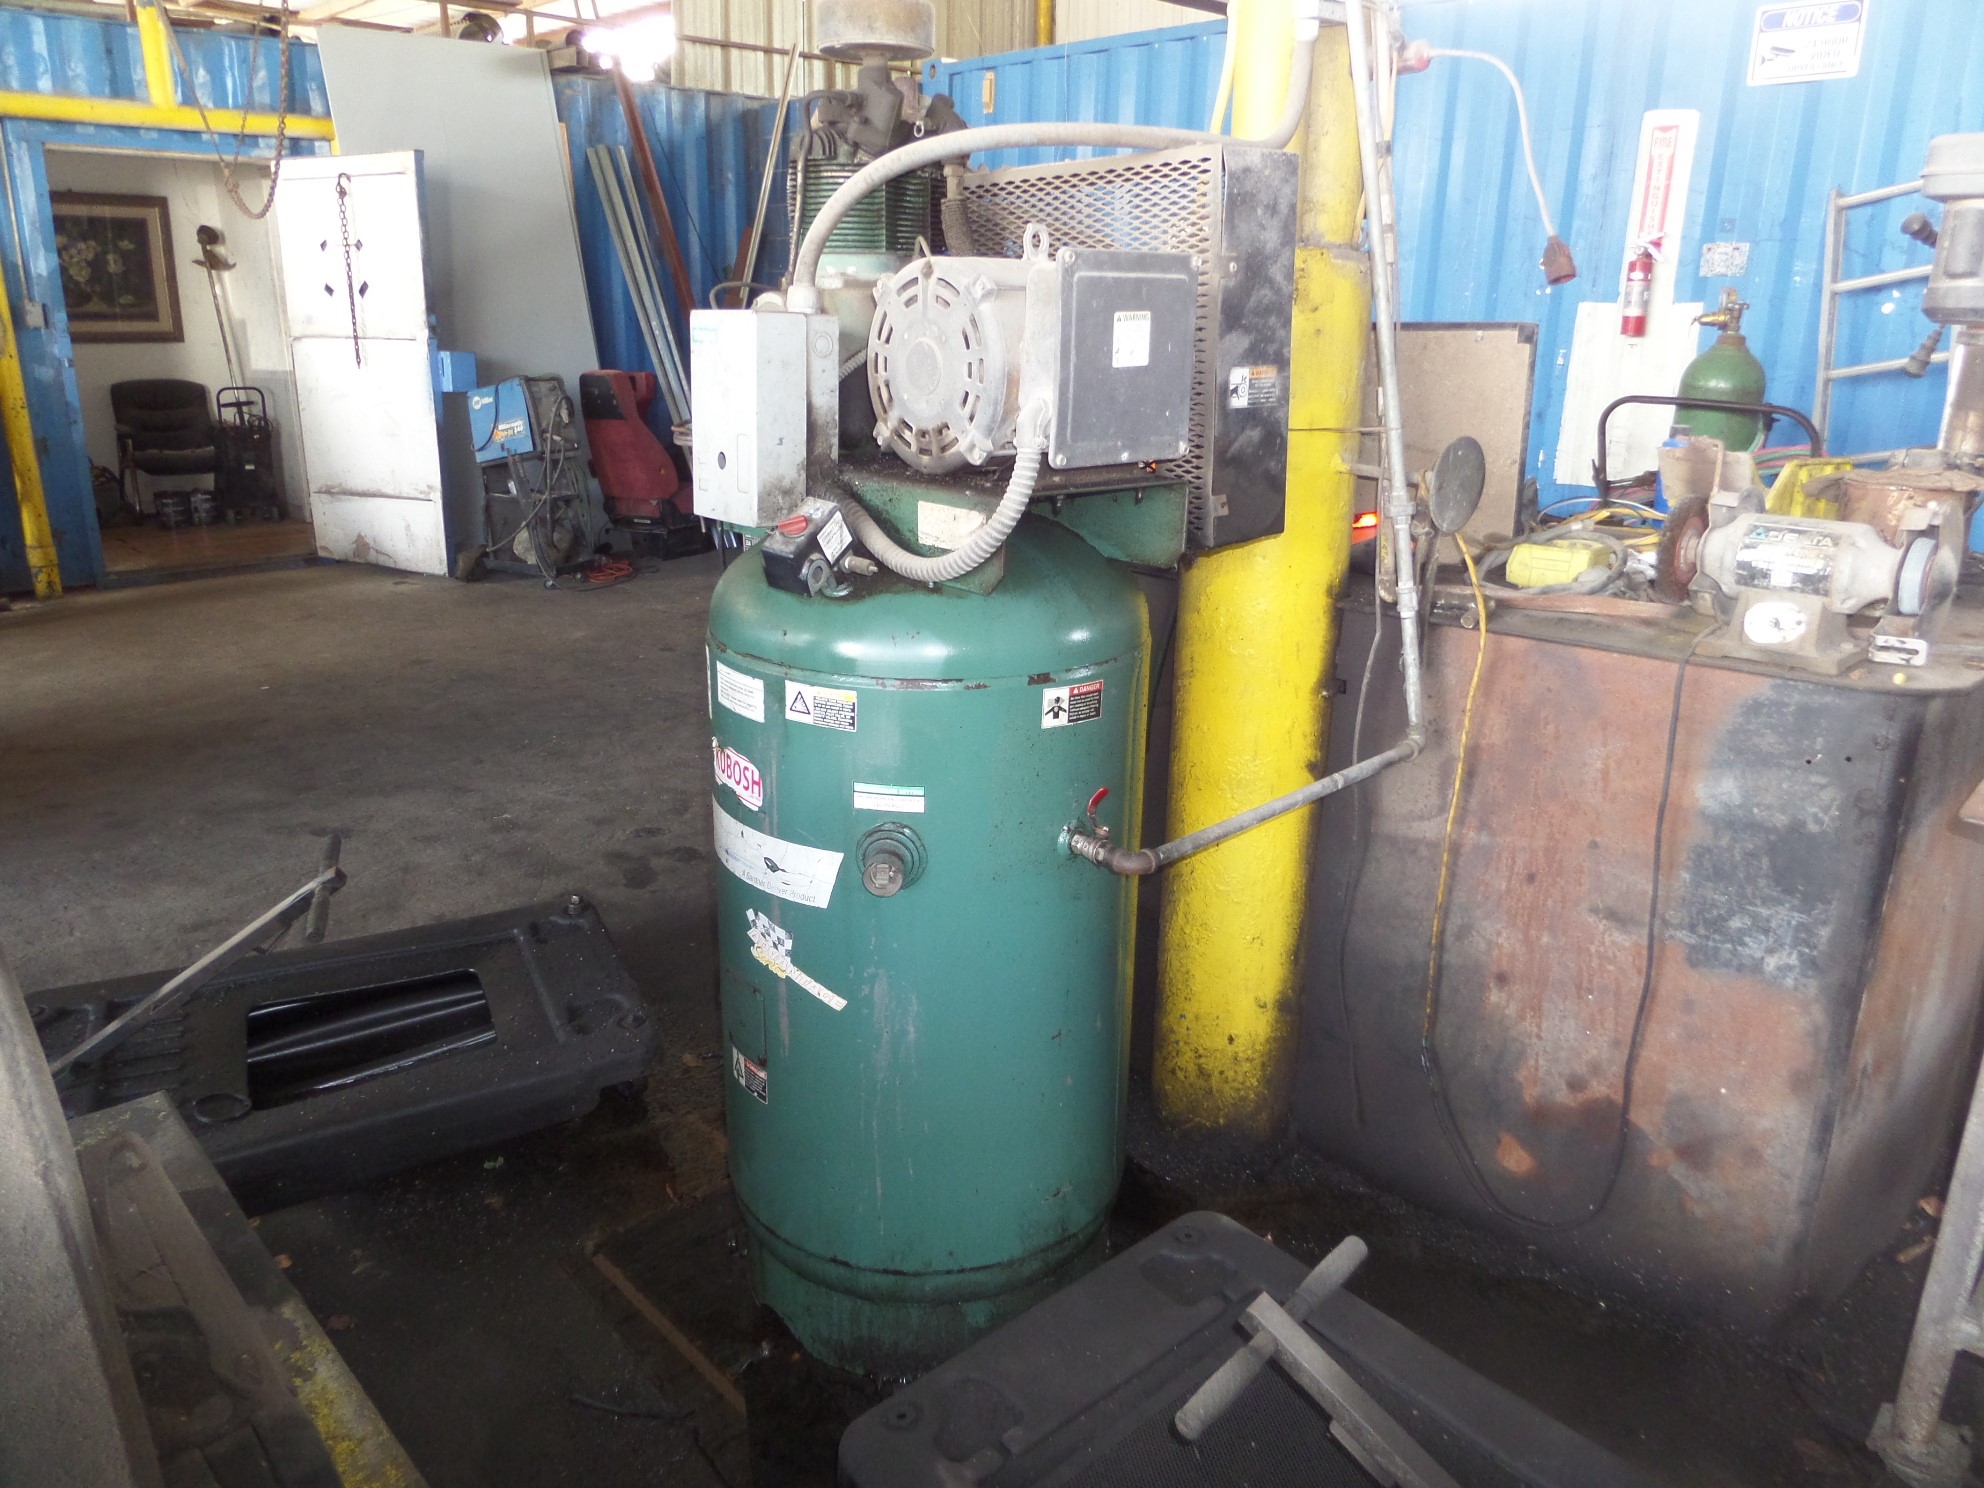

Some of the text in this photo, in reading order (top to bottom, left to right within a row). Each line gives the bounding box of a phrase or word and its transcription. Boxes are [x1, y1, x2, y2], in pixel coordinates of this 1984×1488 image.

[1782, 5, 1840, 28] NOTICE
[1784, 60, 1844, 73] URVEILANCE
[1654, 136, 1673, 148] FIRE
[1647, 153, 1665, 233] EXTINGUISH
[1122, 313, 1149, 322] WARNING
[1079, 684, 1100, 692] DANGER
[715, 748, 762, 798] KUBOSH
[766, 881, 788, 895] Dver
[789, 890, 817, 904] Product
